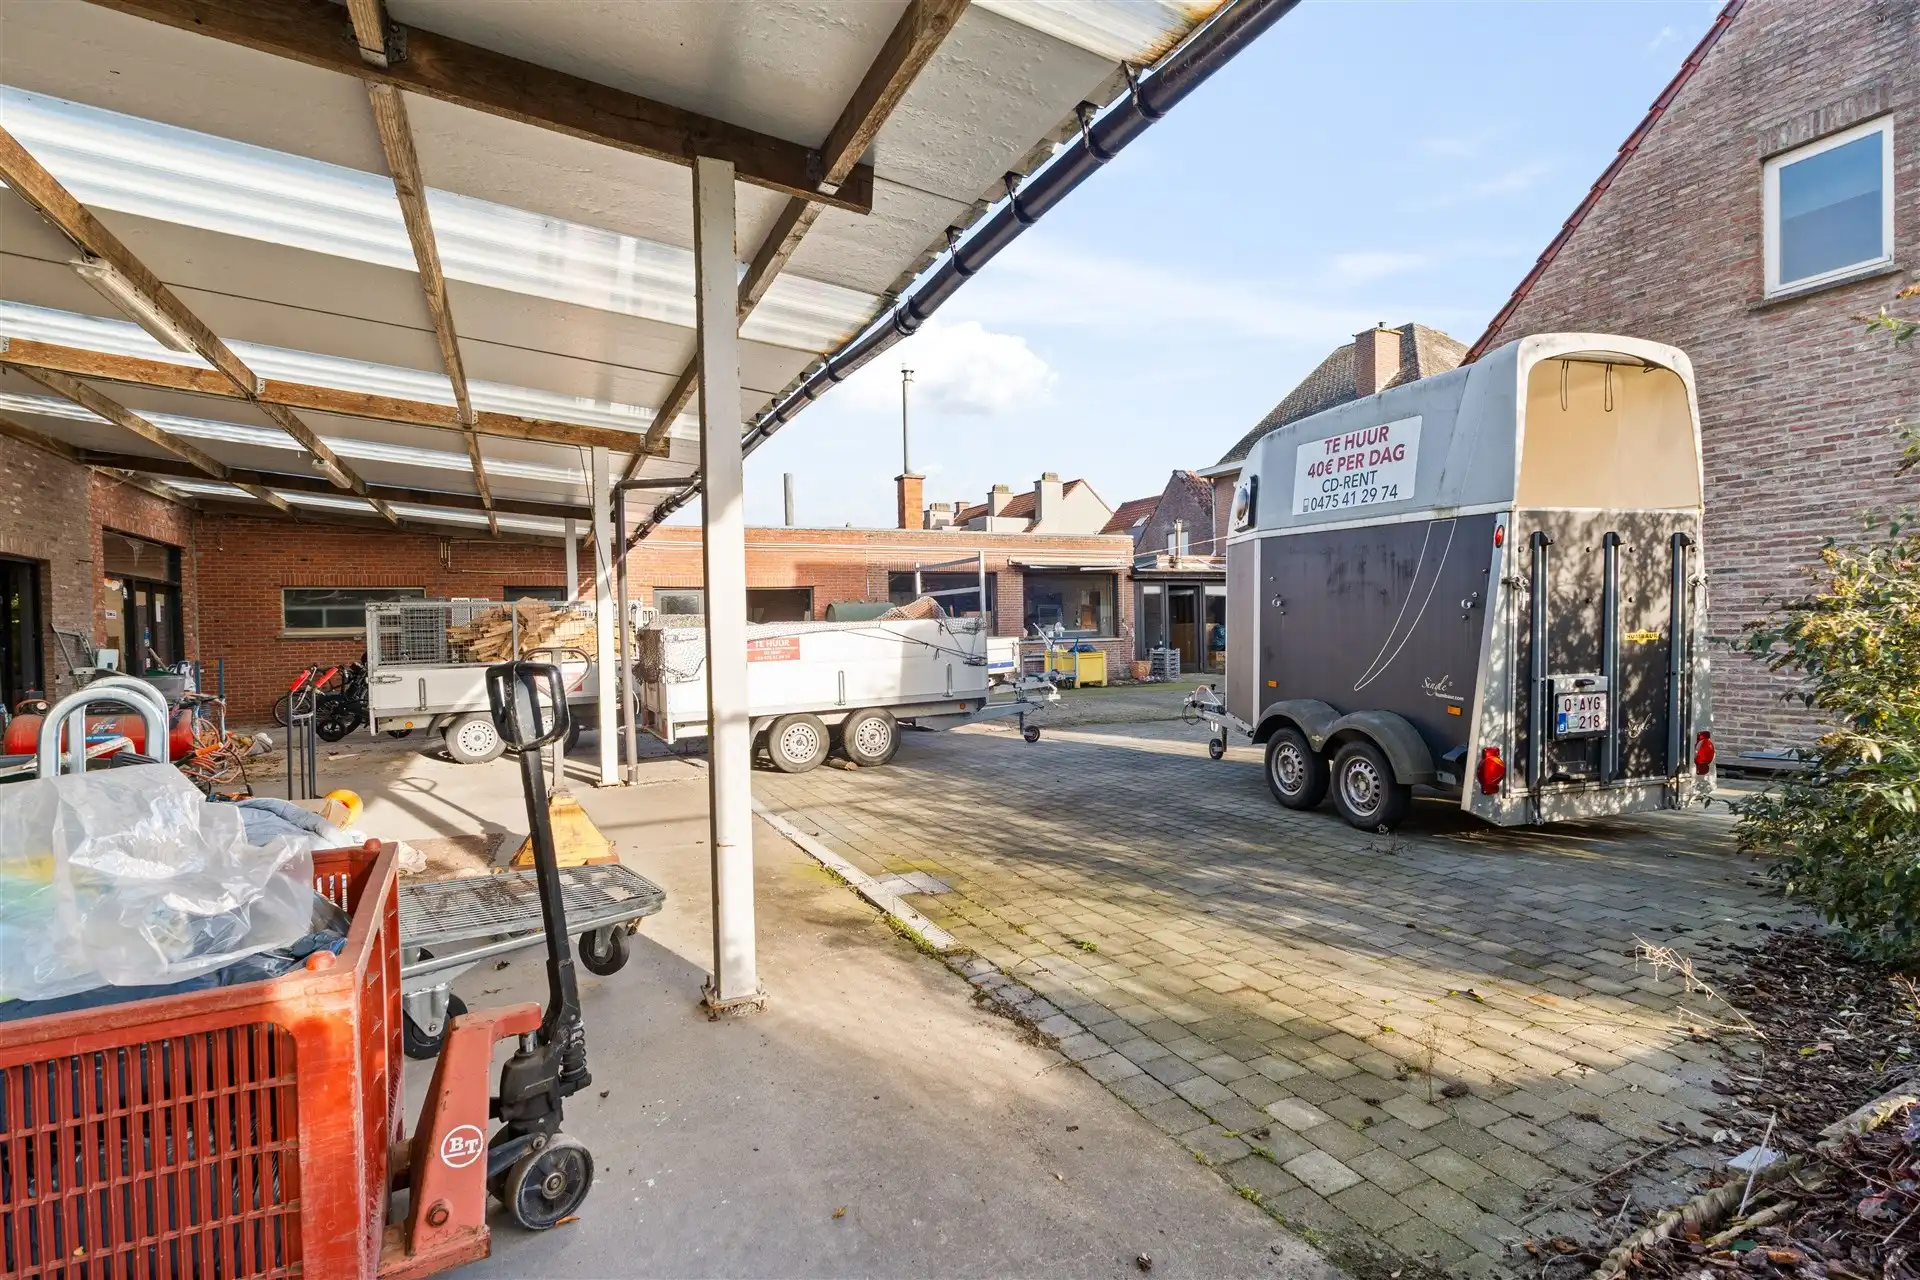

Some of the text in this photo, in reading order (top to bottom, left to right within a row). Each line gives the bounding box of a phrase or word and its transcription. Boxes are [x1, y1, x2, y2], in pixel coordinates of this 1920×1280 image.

[1324, 425, 1389, 455] TE HUUR
[1307, 443, 1406, 478] 40€ PER DAG
[1321, 470, 1378, 493] CD-RENT
[1311, 484, 1398, 511] 0475 41 29 74
[766, 639, 790, 647] HUUR
[1579, 714, 1600, 729] 218
[449, 1136, 479, 1155] BT
